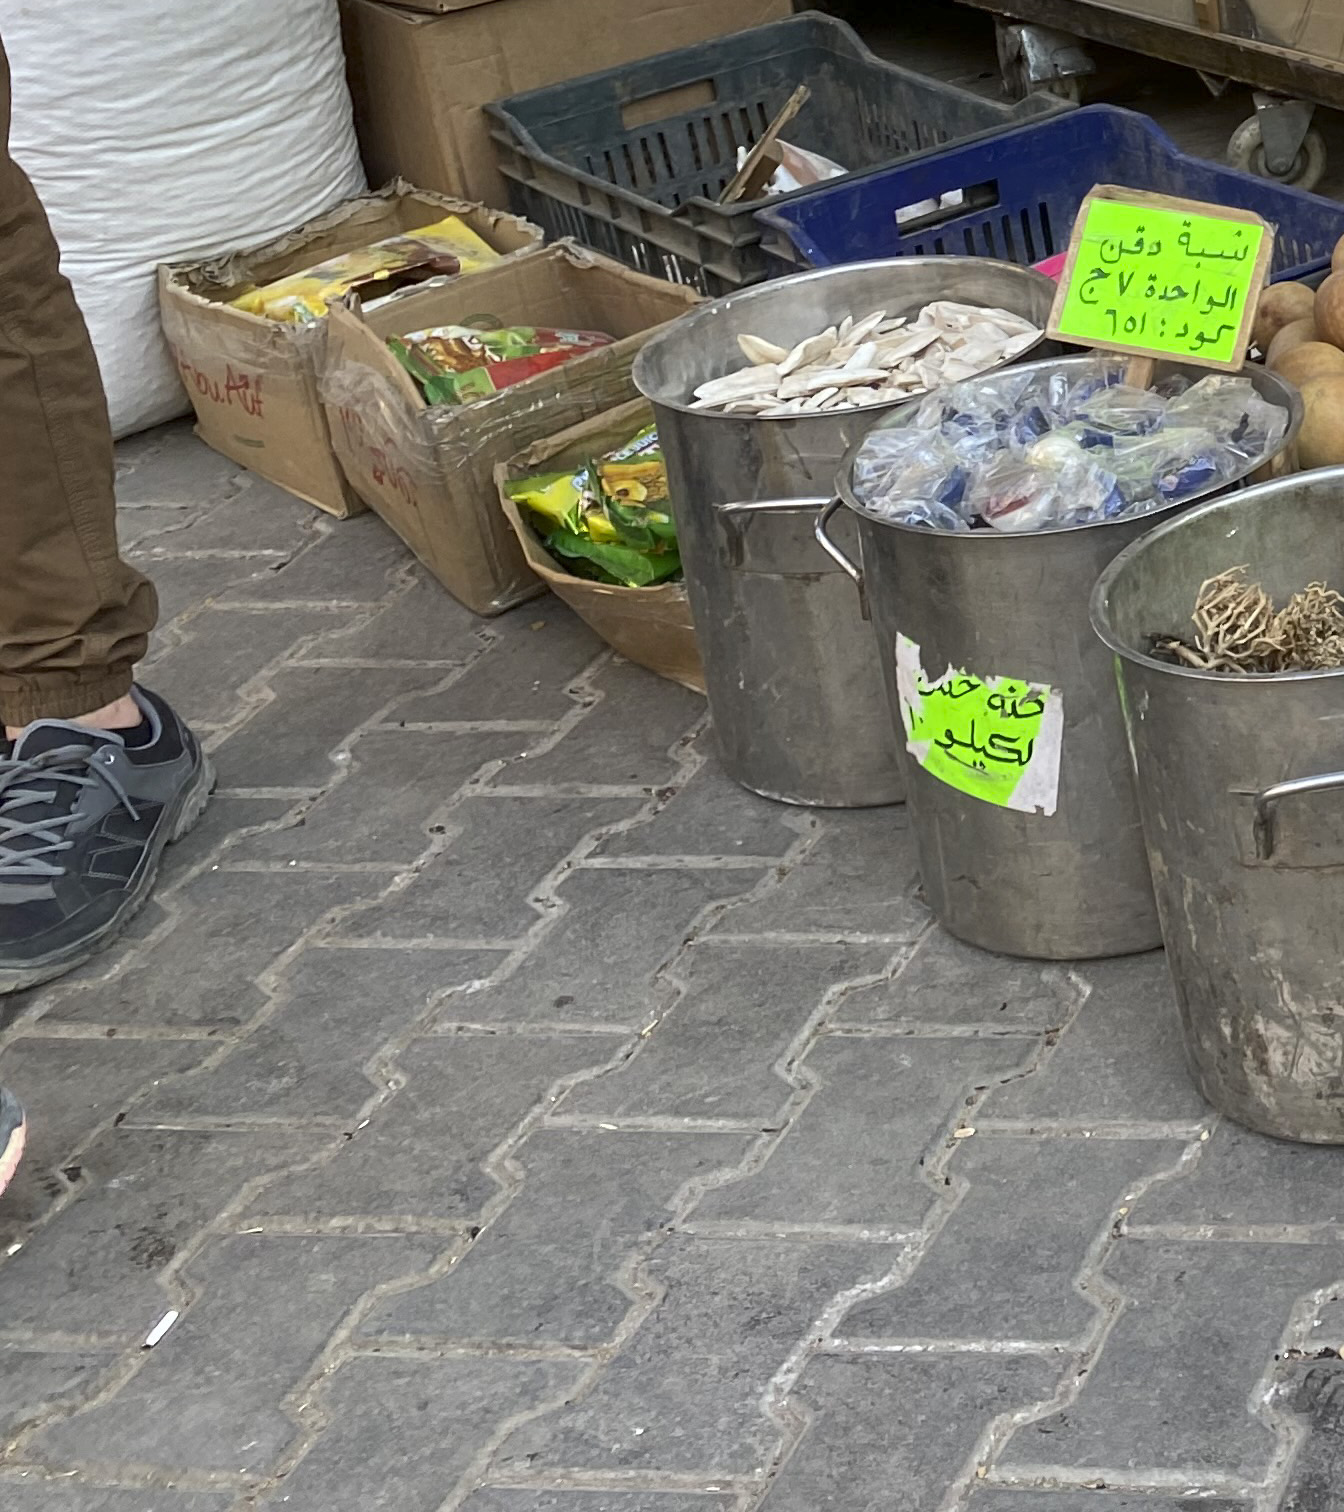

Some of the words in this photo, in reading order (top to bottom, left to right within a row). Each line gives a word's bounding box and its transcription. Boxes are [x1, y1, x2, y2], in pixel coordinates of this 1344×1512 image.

[1099, 225, 1163, 265] دقن
[1079, 267, 1111, 305] ج
[1118, 271, 1135, 298] ٧
[1144, 274, 1238, 315] الواحدة
[1104, 308, 1147, 337] ٦٥١
